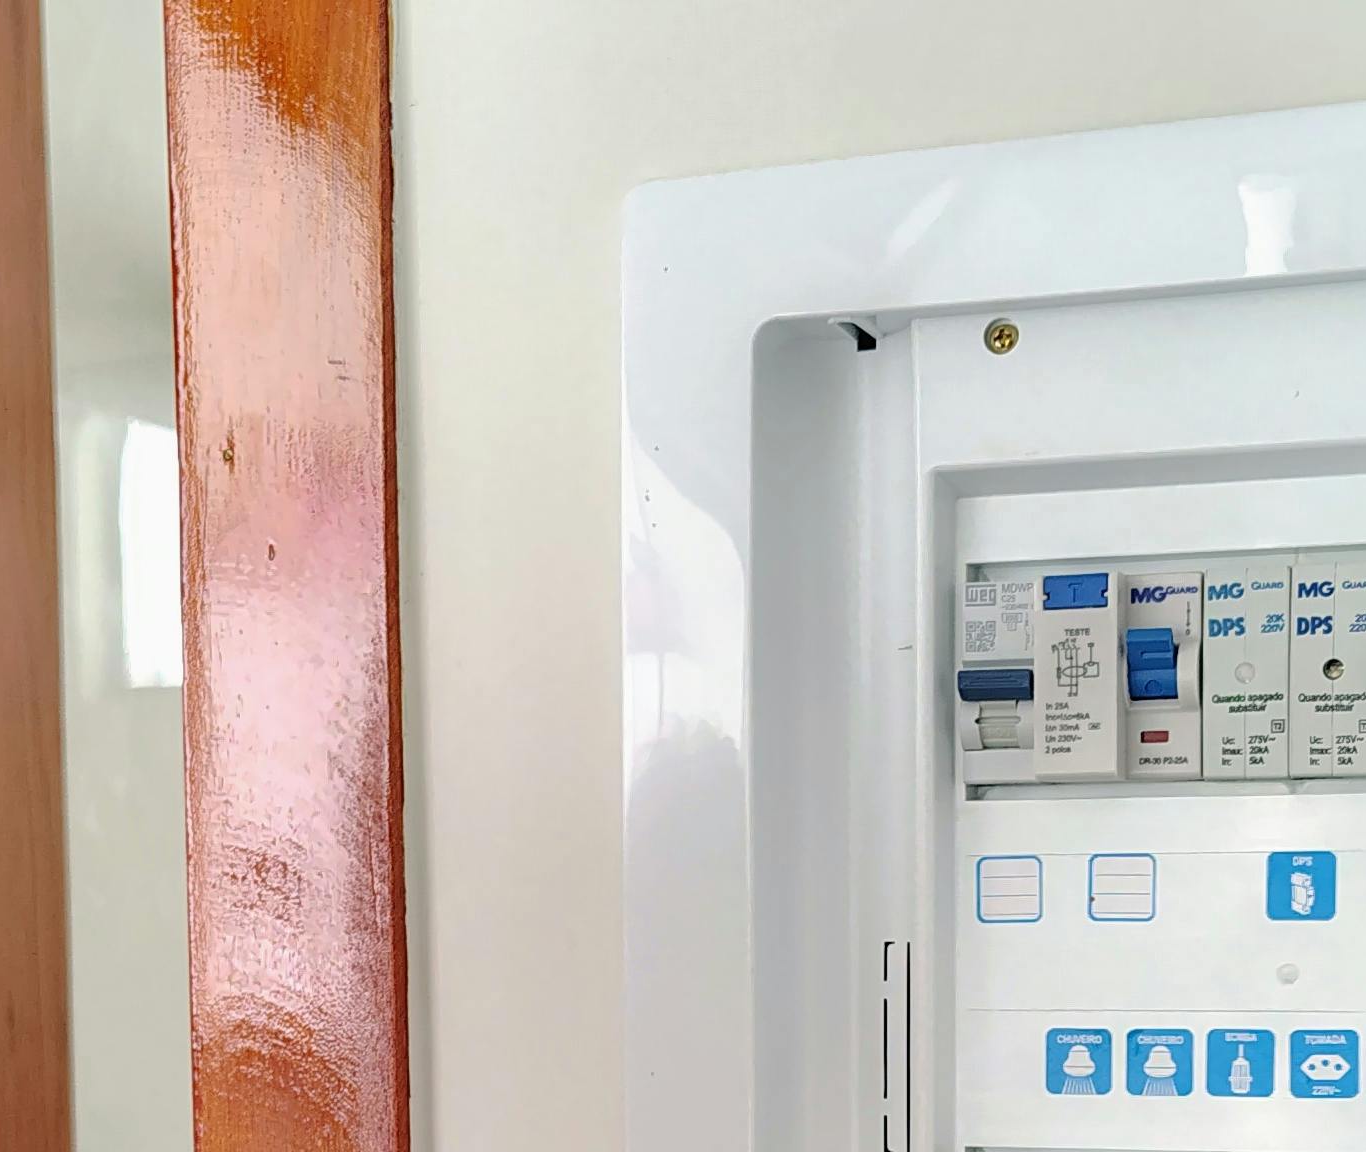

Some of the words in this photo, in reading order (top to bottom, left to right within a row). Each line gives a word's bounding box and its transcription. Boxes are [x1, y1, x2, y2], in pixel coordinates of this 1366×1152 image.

[1208, 583, 1244, 601] MG
[1298, 581, 1335, 598] MG
[1208, 617, 1245, 637] DPS
[1297, 616, 1333, 635] DPS
[1064, 628, 1090, 636] TESTE
[1212, 694, 1245, 703] Quando
[1247, 692, 1284, 705] apagado
[1298, 692, 1332, 702] Quando
[1229, 703, 1267, 713] substituir
[1292, 856, 1313, 867] DPS
[1057, 1034, 1102, 1044] CHUVEIRO
